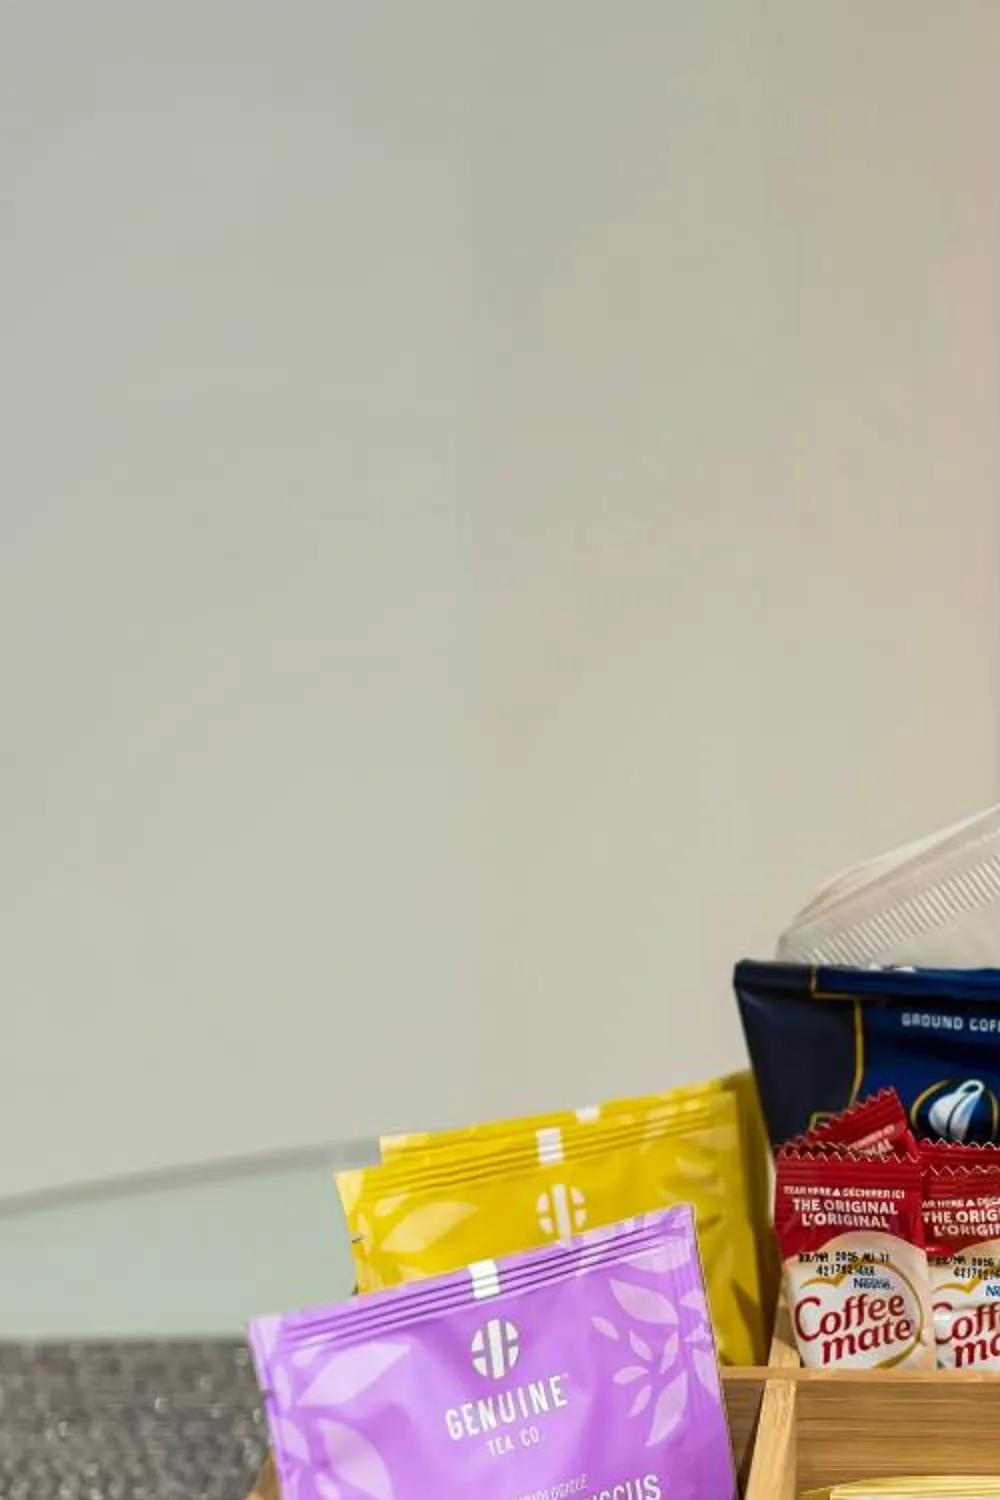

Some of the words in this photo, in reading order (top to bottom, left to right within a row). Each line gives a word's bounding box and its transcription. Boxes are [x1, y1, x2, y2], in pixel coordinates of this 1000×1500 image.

[901, 1012, 964, 1031] GROUND
[792, 1198, 821, 1212] THE
[823, 1200, 899, 1216] ORIGINAL
[922, 1210, 953, 1224] THE
[801, 1213, 890, 1229] L'ORIGINAL
[794, 1292, 905, 1343] Coffee
[822, 1318, 912, 1366] mate
[445, 1375, 568, 1441] GENUINE
[486, 1435, 515, 1458] TEA
